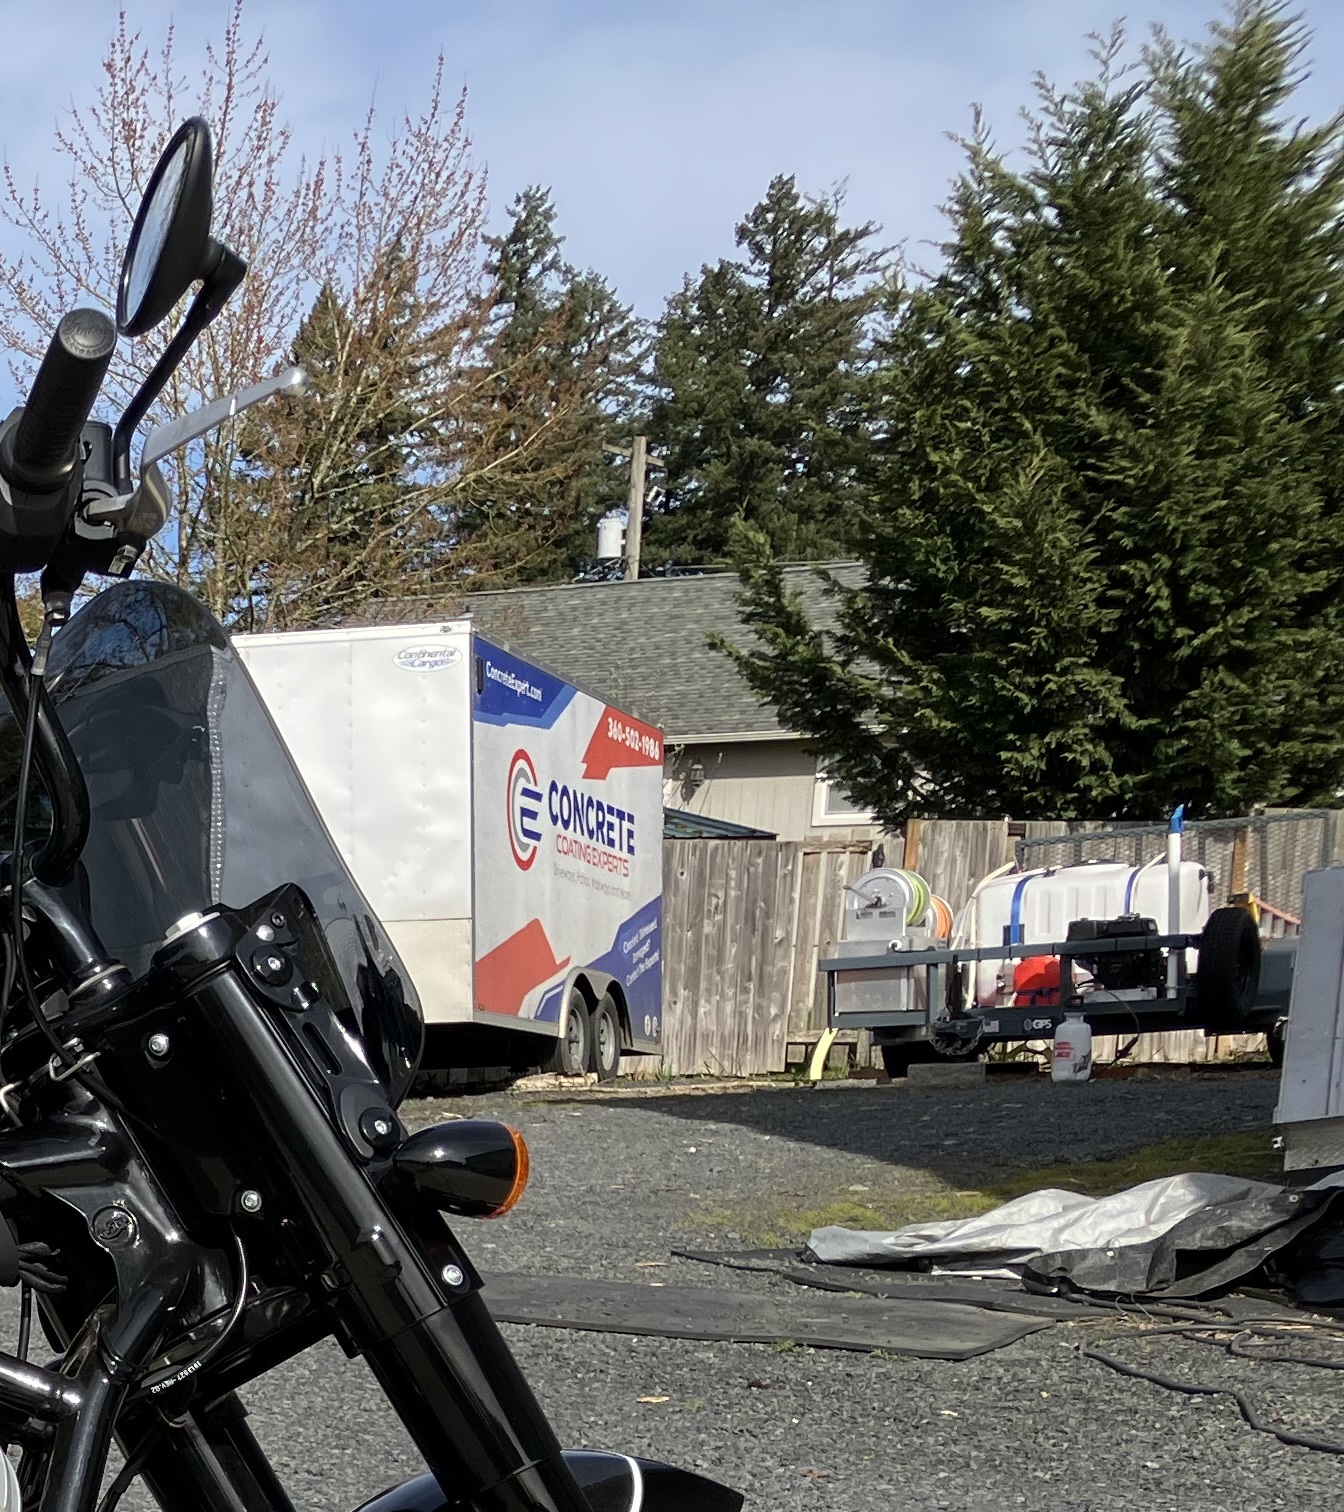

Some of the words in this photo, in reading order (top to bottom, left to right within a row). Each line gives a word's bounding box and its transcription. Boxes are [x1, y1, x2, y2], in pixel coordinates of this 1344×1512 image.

[397, 647, 456, 660] Continental
[412, 659, 444, 669] Cargo
[486, 660, 542, 703] ConcreteExpert.com
[607, 716, 659, 761] 360-502-1986
[548, 779, 635, 856] CONCRETE
[556, 833, 591, 865] COATING
[590, 846, 630, 878] EXPERTS
[1032, 1019, 1052, 1030] GPS
